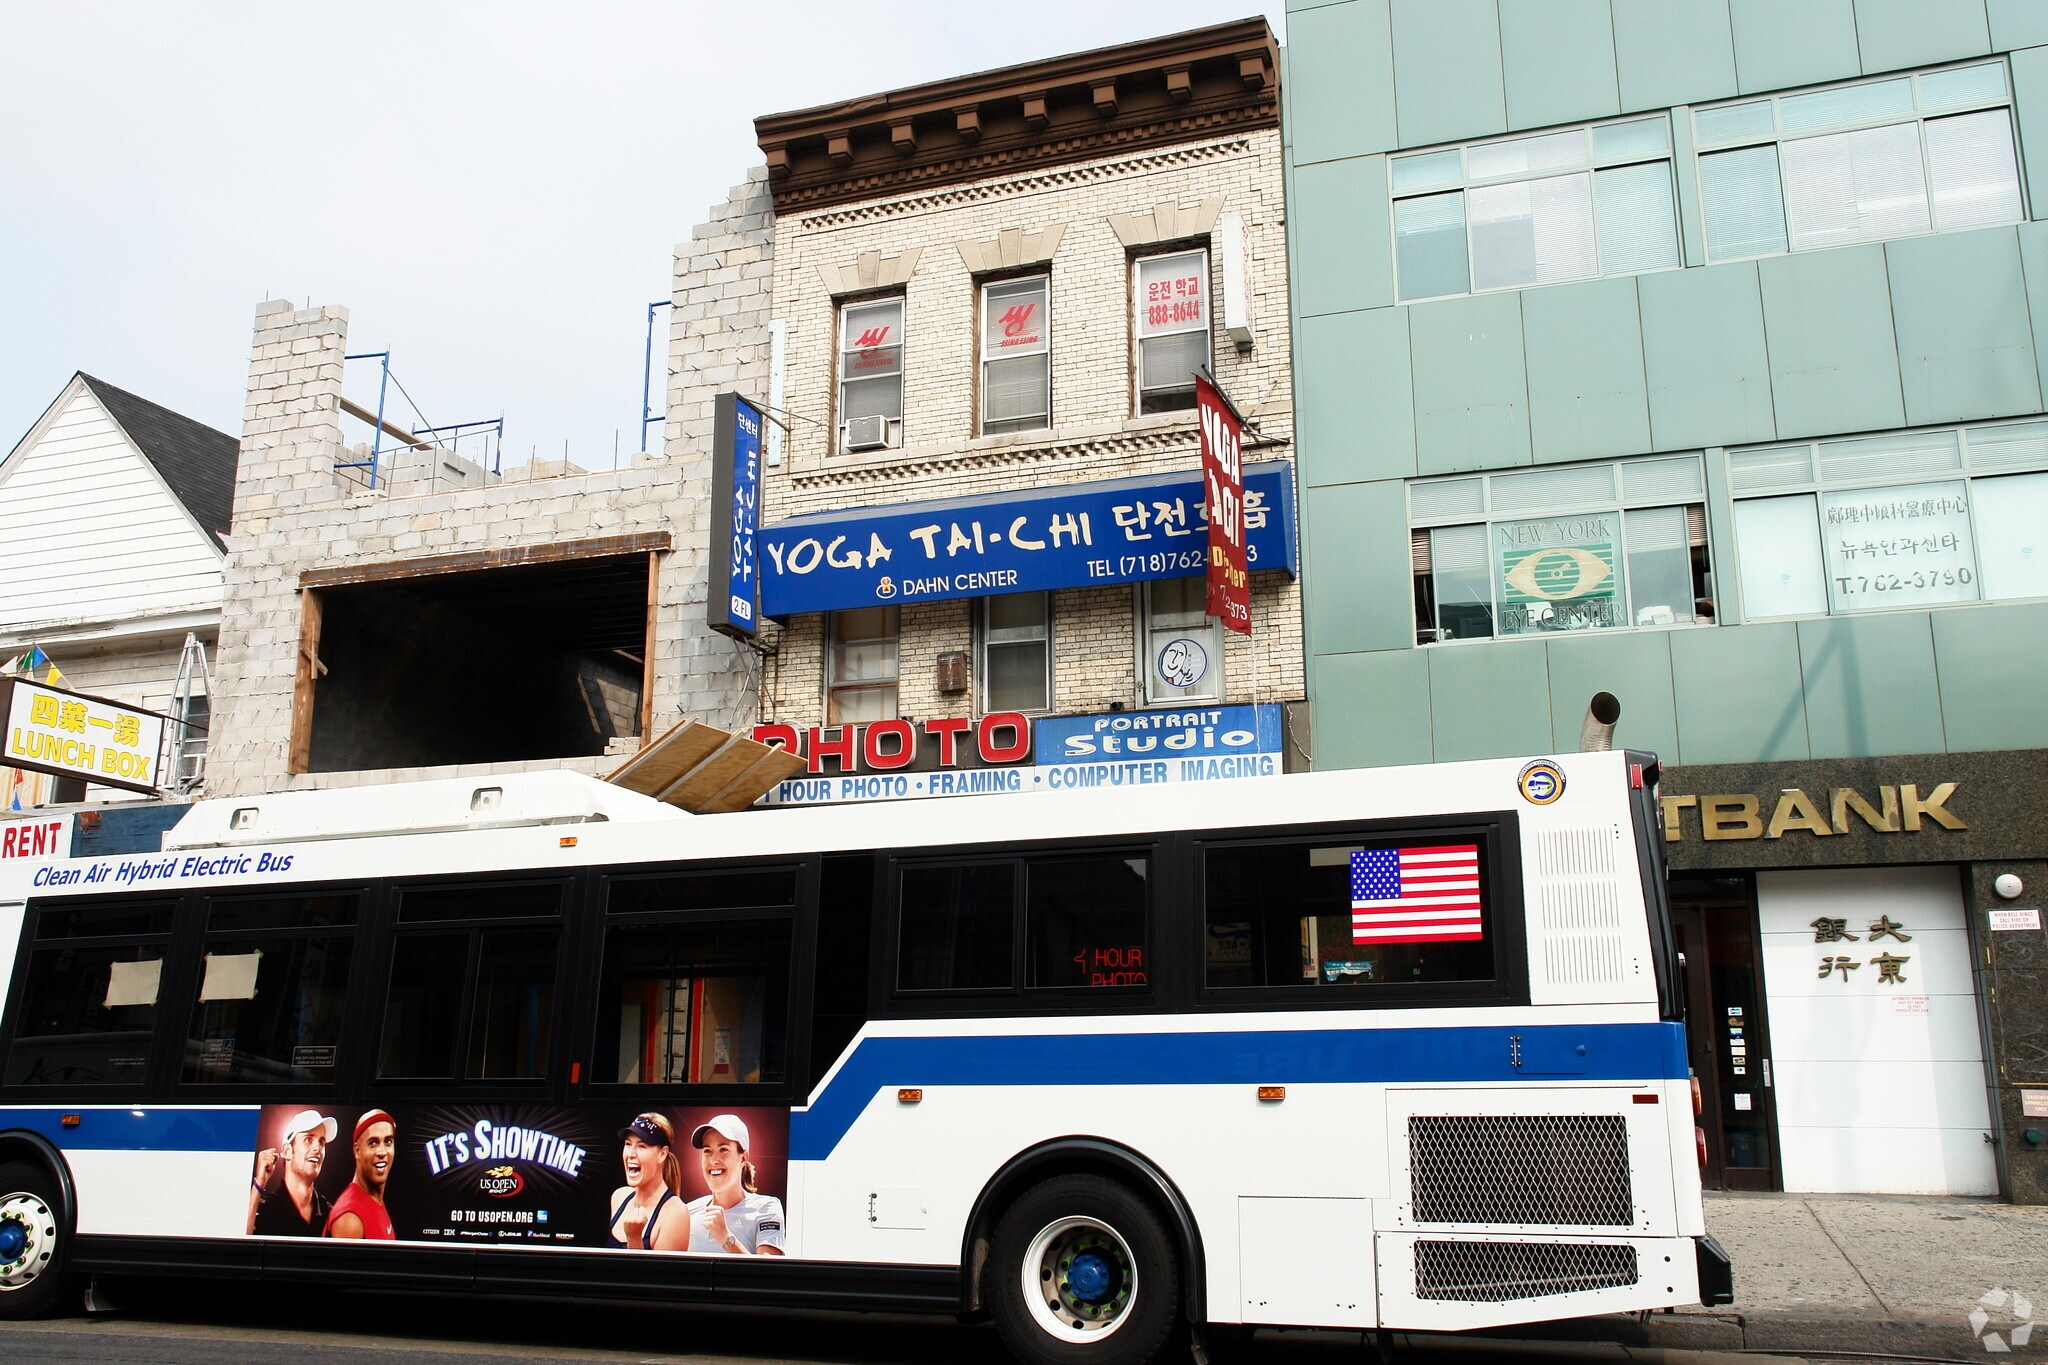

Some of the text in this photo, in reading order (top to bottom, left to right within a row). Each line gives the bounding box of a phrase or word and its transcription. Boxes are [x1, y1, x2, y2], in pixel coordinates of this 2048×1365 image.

[1149, 276, 1198, 302] 운전 학교
[1149, 300, 1199, 325] 888-8644
[1202, 403, 1240, 486] YOGA
[733, 485, 744, 577] YOGA
[744, 450, 757, 583] TAI-CHI
[1501, 519, 1610, 544] NEW YORK
[767, 511, 1093, 576] YOGA TAI-CHI
[1087, 545, 1258, 577] TEL (718)762-3
[903, 570, 1017, 596] DAHN CENTER
[734, 599, 749, 617] 2 FL
[1502, 602, 1623, 629] EYE CENTER
[30, 693, 141, 747] 四菜一湯
[1095, 711, 1222, 732] PORTRAIT
[12, 728, 151, 781] LUNCH BOX
[1064, 726, 1255, 757] Studio
[780, 781, 831, 802] HOUR
[842, 776, 908, 799] PHOTO
[929, 769, 1021, 795] FRAMING
[1049, 762, 1168, 788] COMPUTER
[1181, 756, 1273, 782] IMAGING
[2, 822, 62, 858] RENT
[33, 852, 294, 887] Clean Air Hybrid Electric Bus
[1095, 948, 1143, 967] HOUR
[425, 1119, 587, 1178] IT'S SHOWTIME
[480, 1178, 517, 1189] US OPEN
[451, 1210, 463, 1221] GO
[465, 1210, 476, 1222] TO
[478, 1211, 533, 1223] USOPEN.ORG
